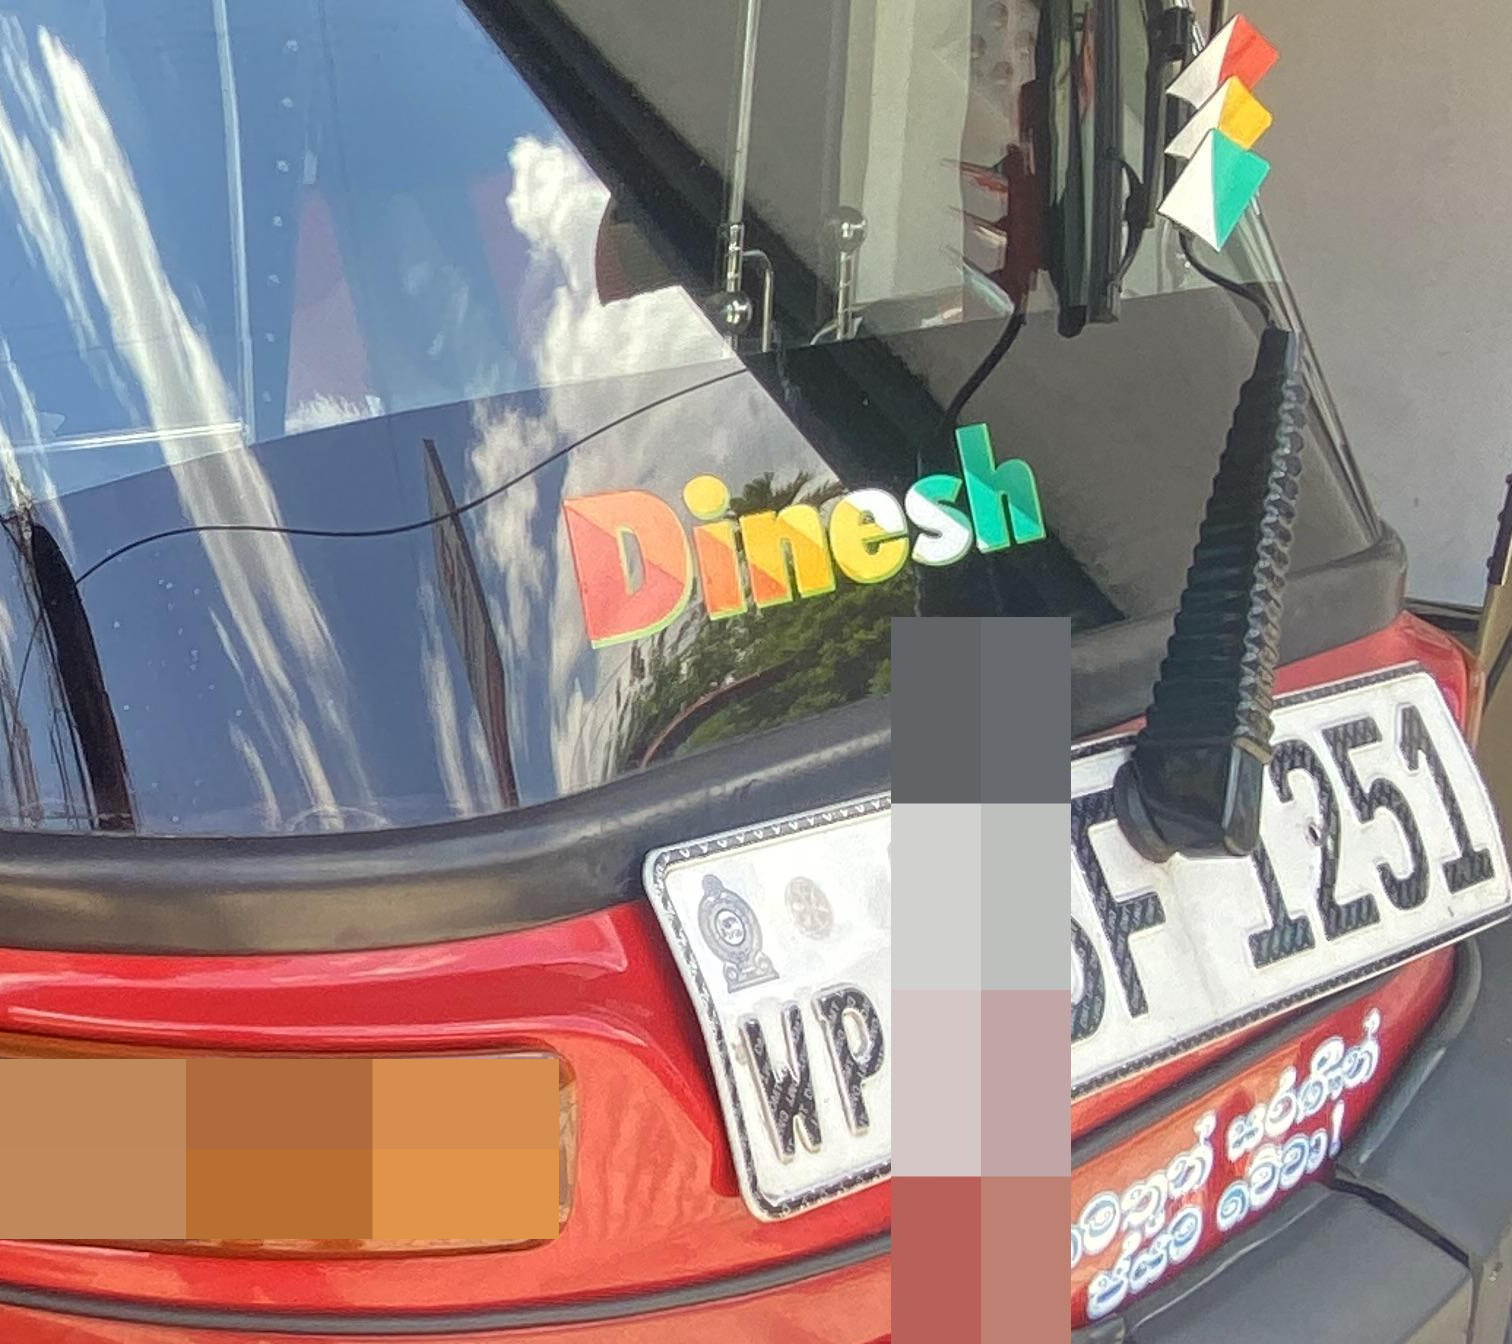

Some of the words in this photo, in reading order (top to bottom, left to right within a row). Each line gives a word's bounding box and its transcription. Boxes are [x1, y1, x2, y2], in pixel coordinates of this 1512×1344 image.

[563, 422, 1047, 650] Dinesh
[738, 982, 886, 1165] WP
[1247, 703, 1494, 969] 1251
